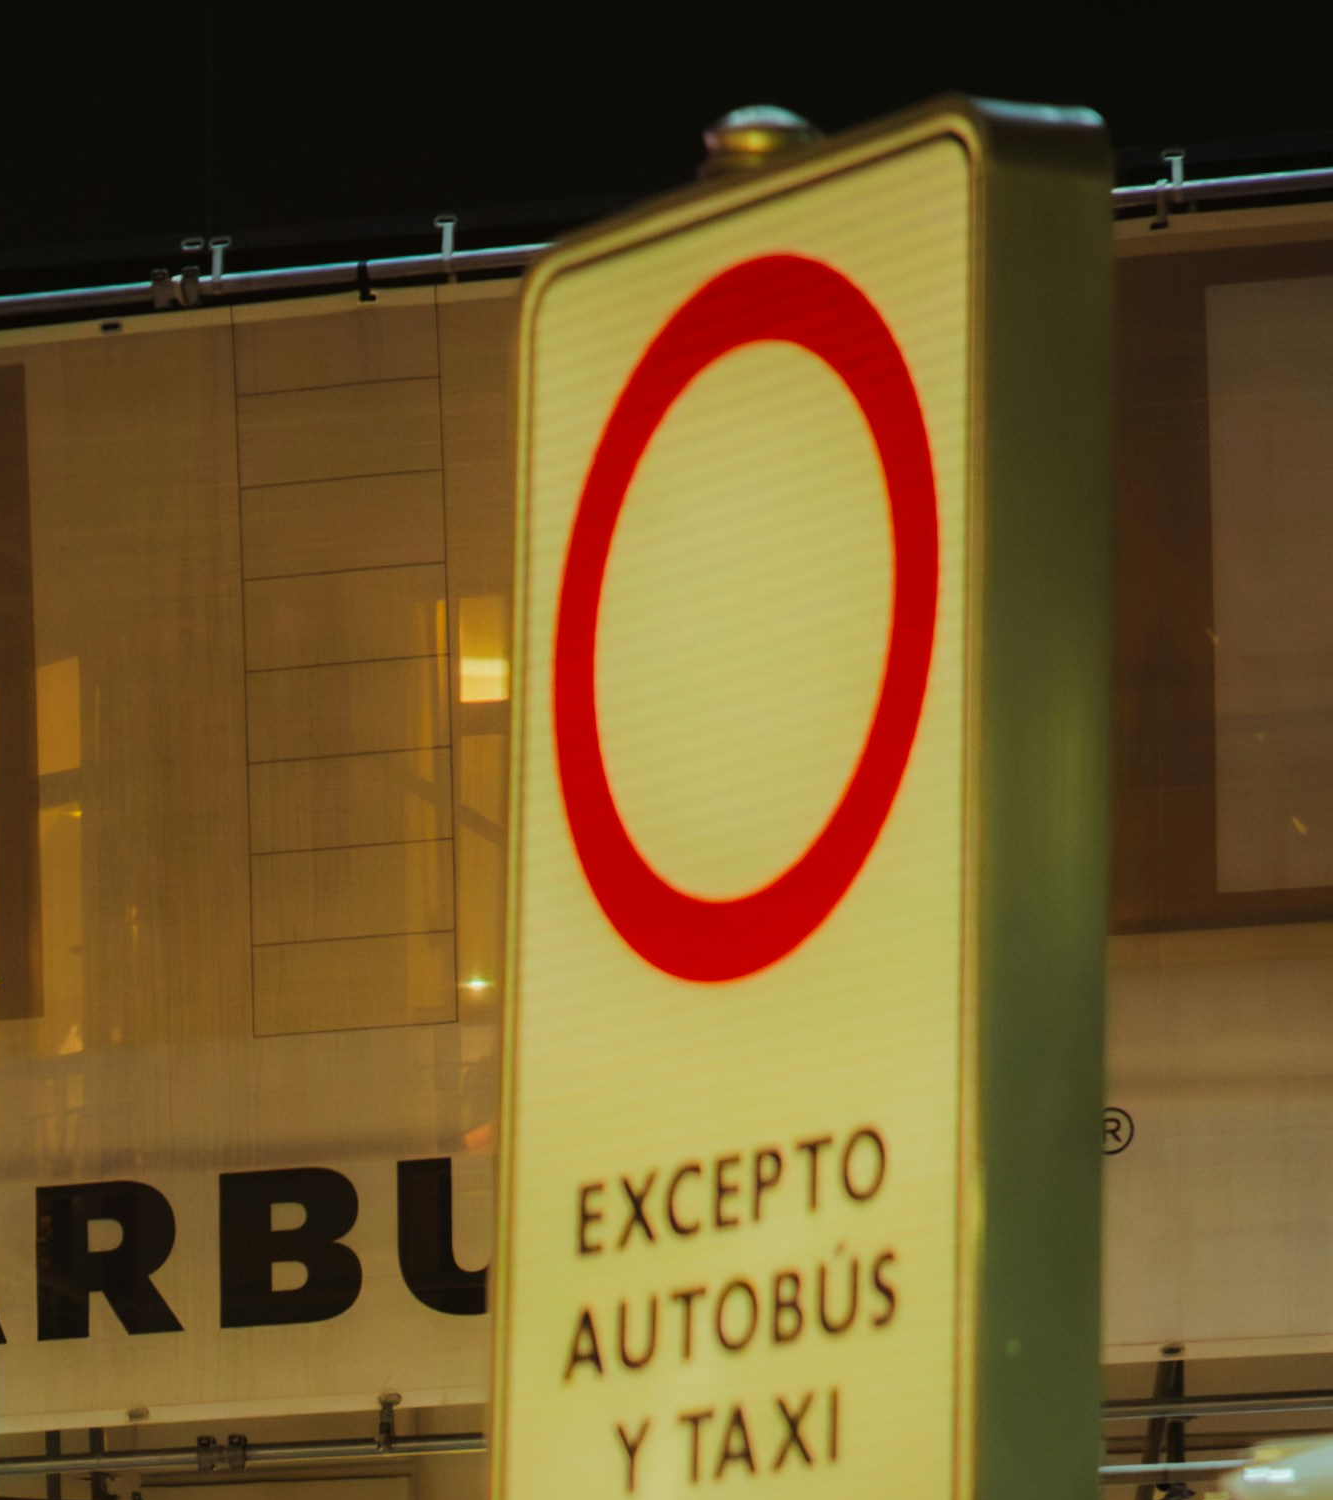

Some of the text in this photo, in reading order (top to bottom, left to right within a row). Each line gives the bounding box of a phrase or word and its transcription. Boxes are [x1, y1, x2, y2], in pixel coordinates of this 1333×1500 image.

[575, 1127, 888, 1258] EXCEPTO
[563, 1241, 899, 1382] AUTOBÚS
[615, 1385, 843, 1494] Y TAXI
